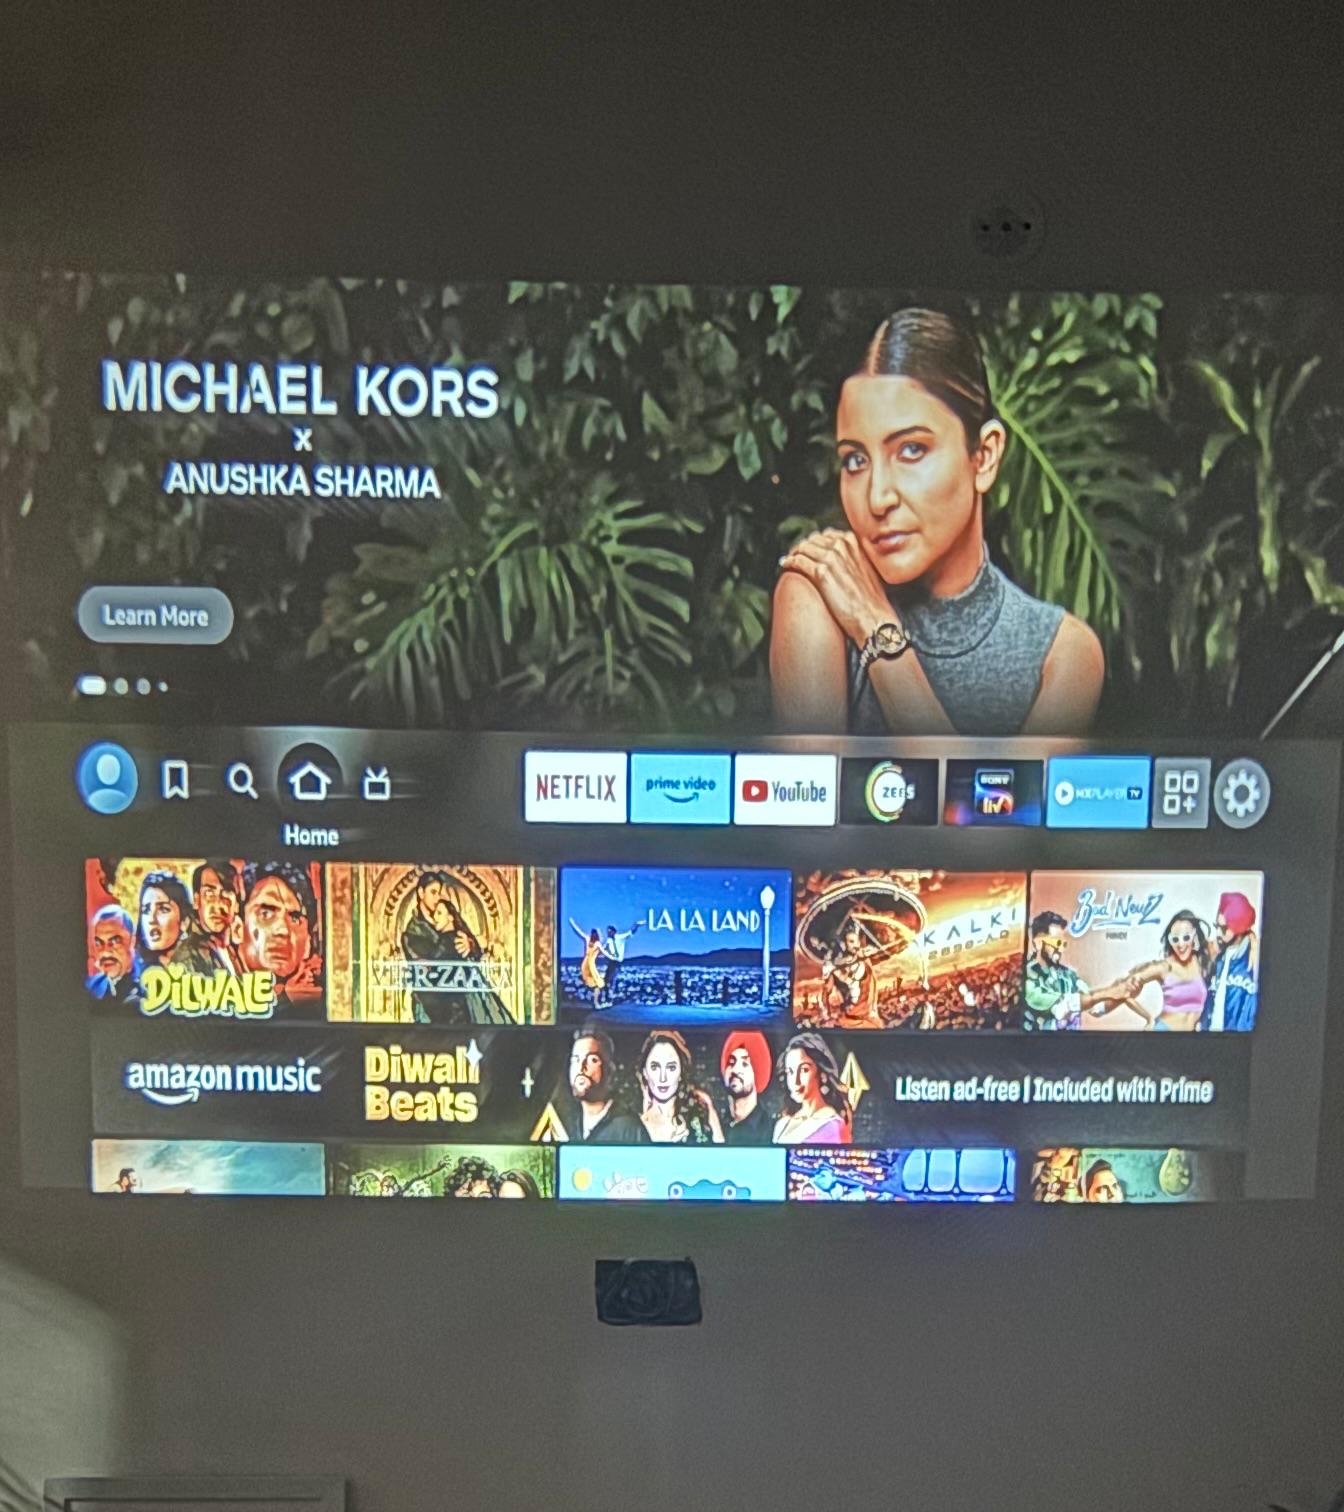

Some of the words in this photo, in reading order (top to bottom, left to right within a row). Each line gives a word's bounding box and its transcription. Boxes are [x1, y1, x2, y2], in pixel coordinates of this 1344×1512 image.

[102, 361, 338, 415] MICHAEL
[355, 365, 501, 418] KORS
[164, 462, 310, 496] ANUSHKA
[313, 464, 442, 499] SHARMA
[102, 604, 157, 627] Learn
[159, 604, 210, 628] More
[536, 773, 616, 803] NETFLIX
[646, 775, 682, 791] prime
[683, 774, 717, 791] video
[771, 780, 827, 803] YouTube
[284, 823, 341, 846] Home
[648, 908, 674, 932] LA
[680, 908, 705, 932] LA
[712, 909, 761, 933] LAND
[923, 907, 1017, 948] KALKI
[1070, 889, 1111, 934] Bad
[127, 1062, 232, 1092] amazon
[235, 1057, 322, 1092] music
[364, 1045, 480, 1084] Diwali
[364, 1084, 478, 1123] Beats
[896, 1076, 951, 1101] Listen
[953, 1077, 1020, 1102] ad-free
[1033, 1077, 1113, 1103] Included
[1116, 1076, 1156, 1103] with
[1159, 1077, 1214, 1103] Prime
